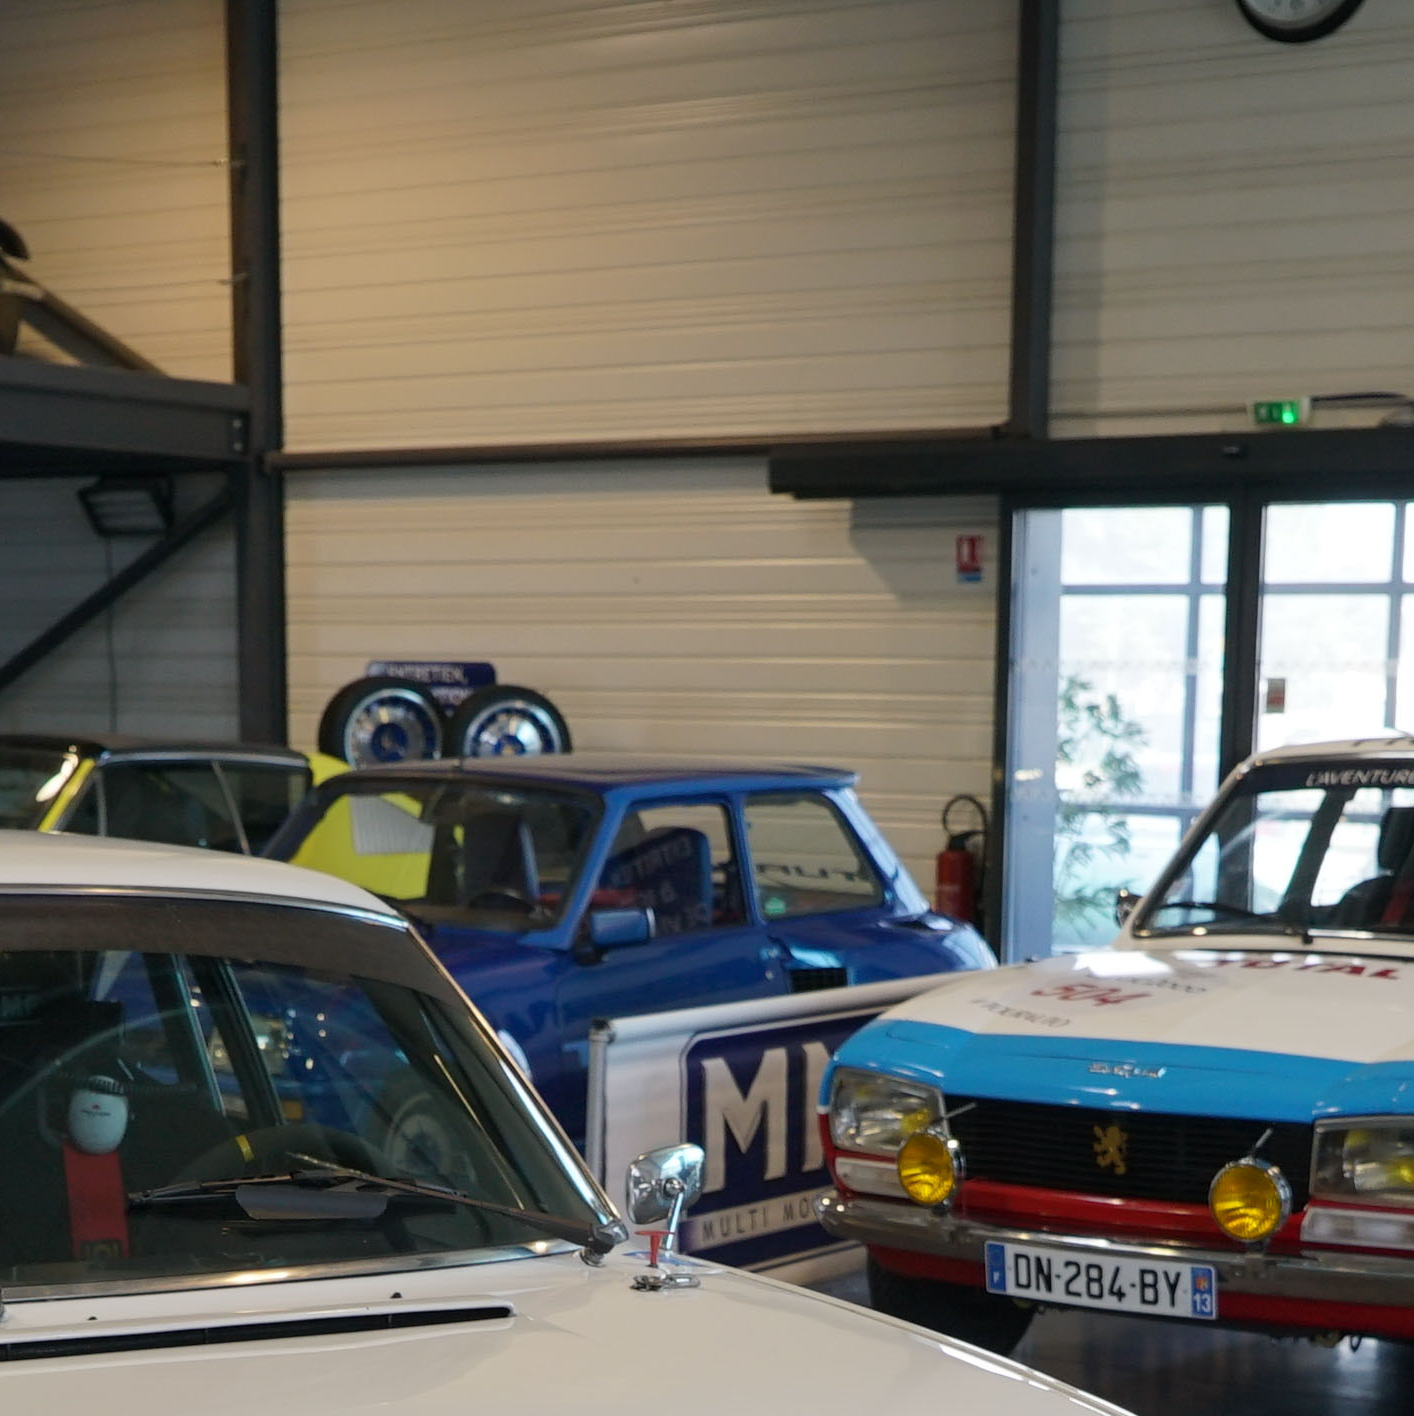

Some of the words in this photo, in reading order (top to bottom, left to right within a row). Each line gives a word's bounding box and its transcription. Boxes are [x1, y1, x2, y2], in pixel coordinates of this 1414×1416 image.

[702, 1207, 768, 1242] MULTI
[783, 1197, 817, 1222] MO
[1013, 1253, 1181, 1308] DN-284-BY
[1193, 1292, 1211, 1314] 13
